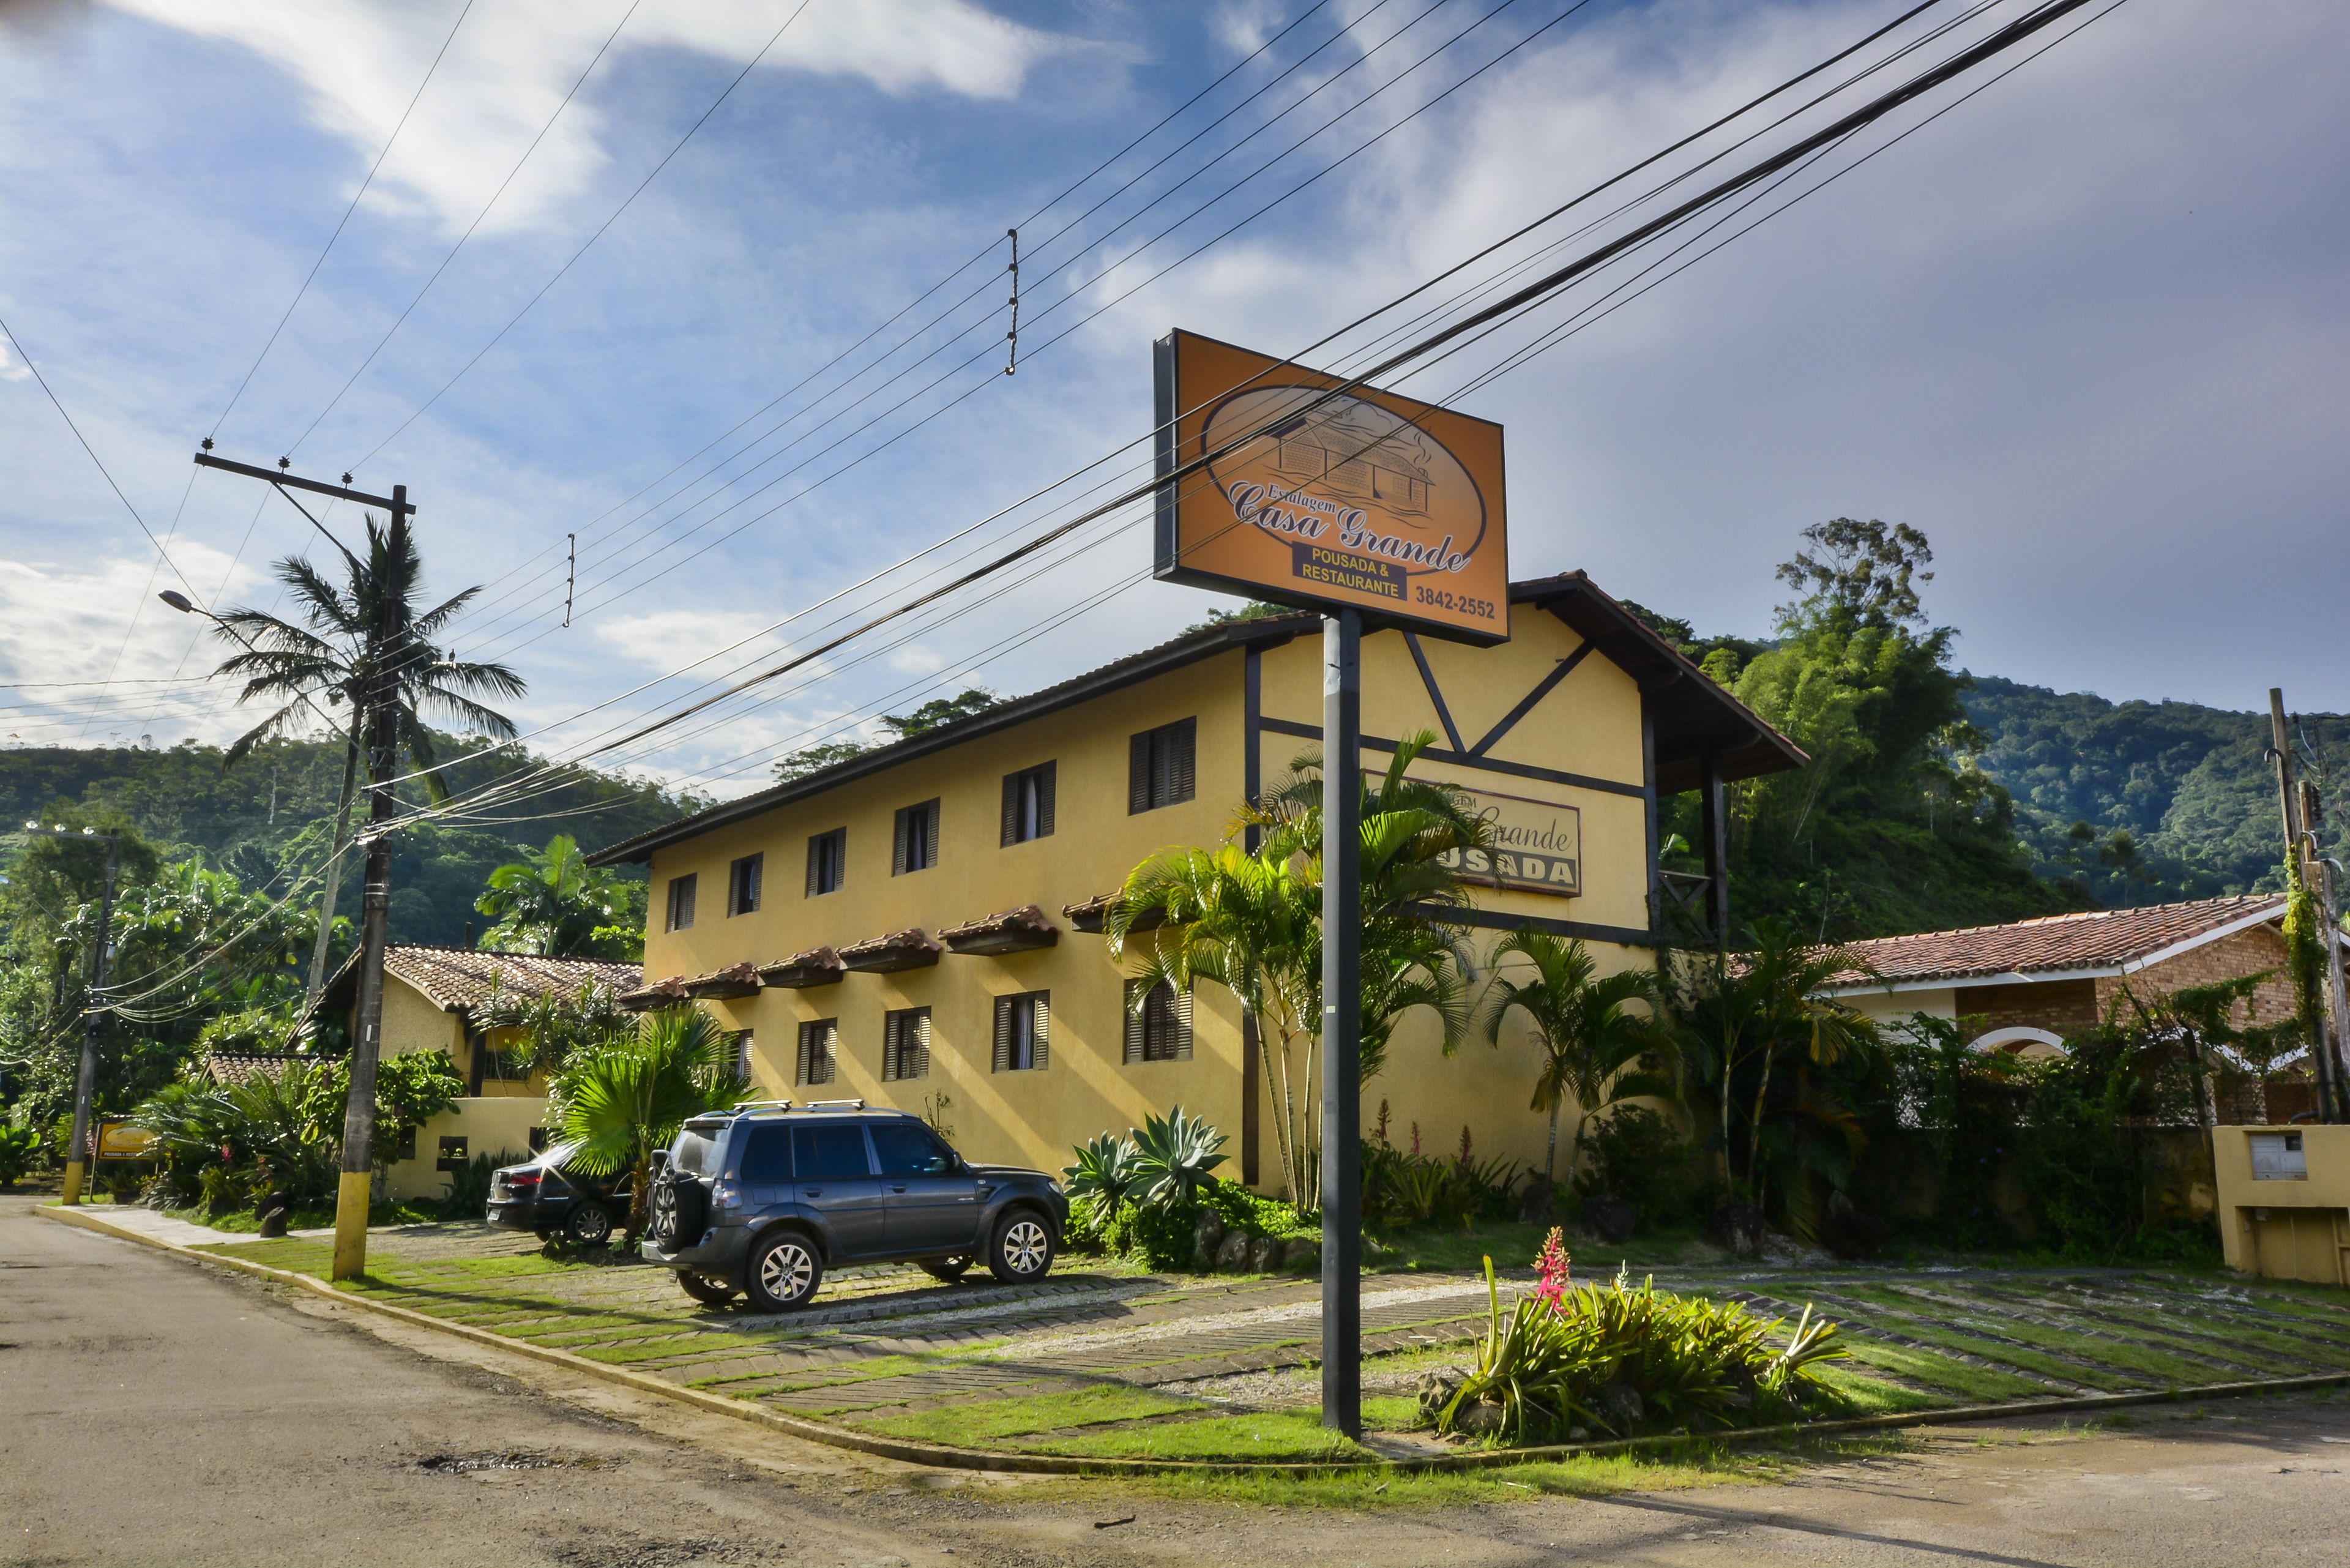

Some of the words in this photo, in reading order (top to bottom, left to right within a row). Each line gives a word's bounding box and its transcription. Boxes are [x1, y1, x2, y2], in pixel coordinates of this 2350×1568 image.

[1267, 483, 1337, 513] Estalagem
[1228, 480, 1330, 539] Casa
[1337, 507, 1471, 573] Grande
[1312, 548, 1377, 575] POUSADA
[1379, 563, 1389, 577] &
[1302, 563, 1399, 597] RESTAURANTE
[1416, 585, 1495, 619] 3842-2552
[1436, 846, 1575, 885] USADA
